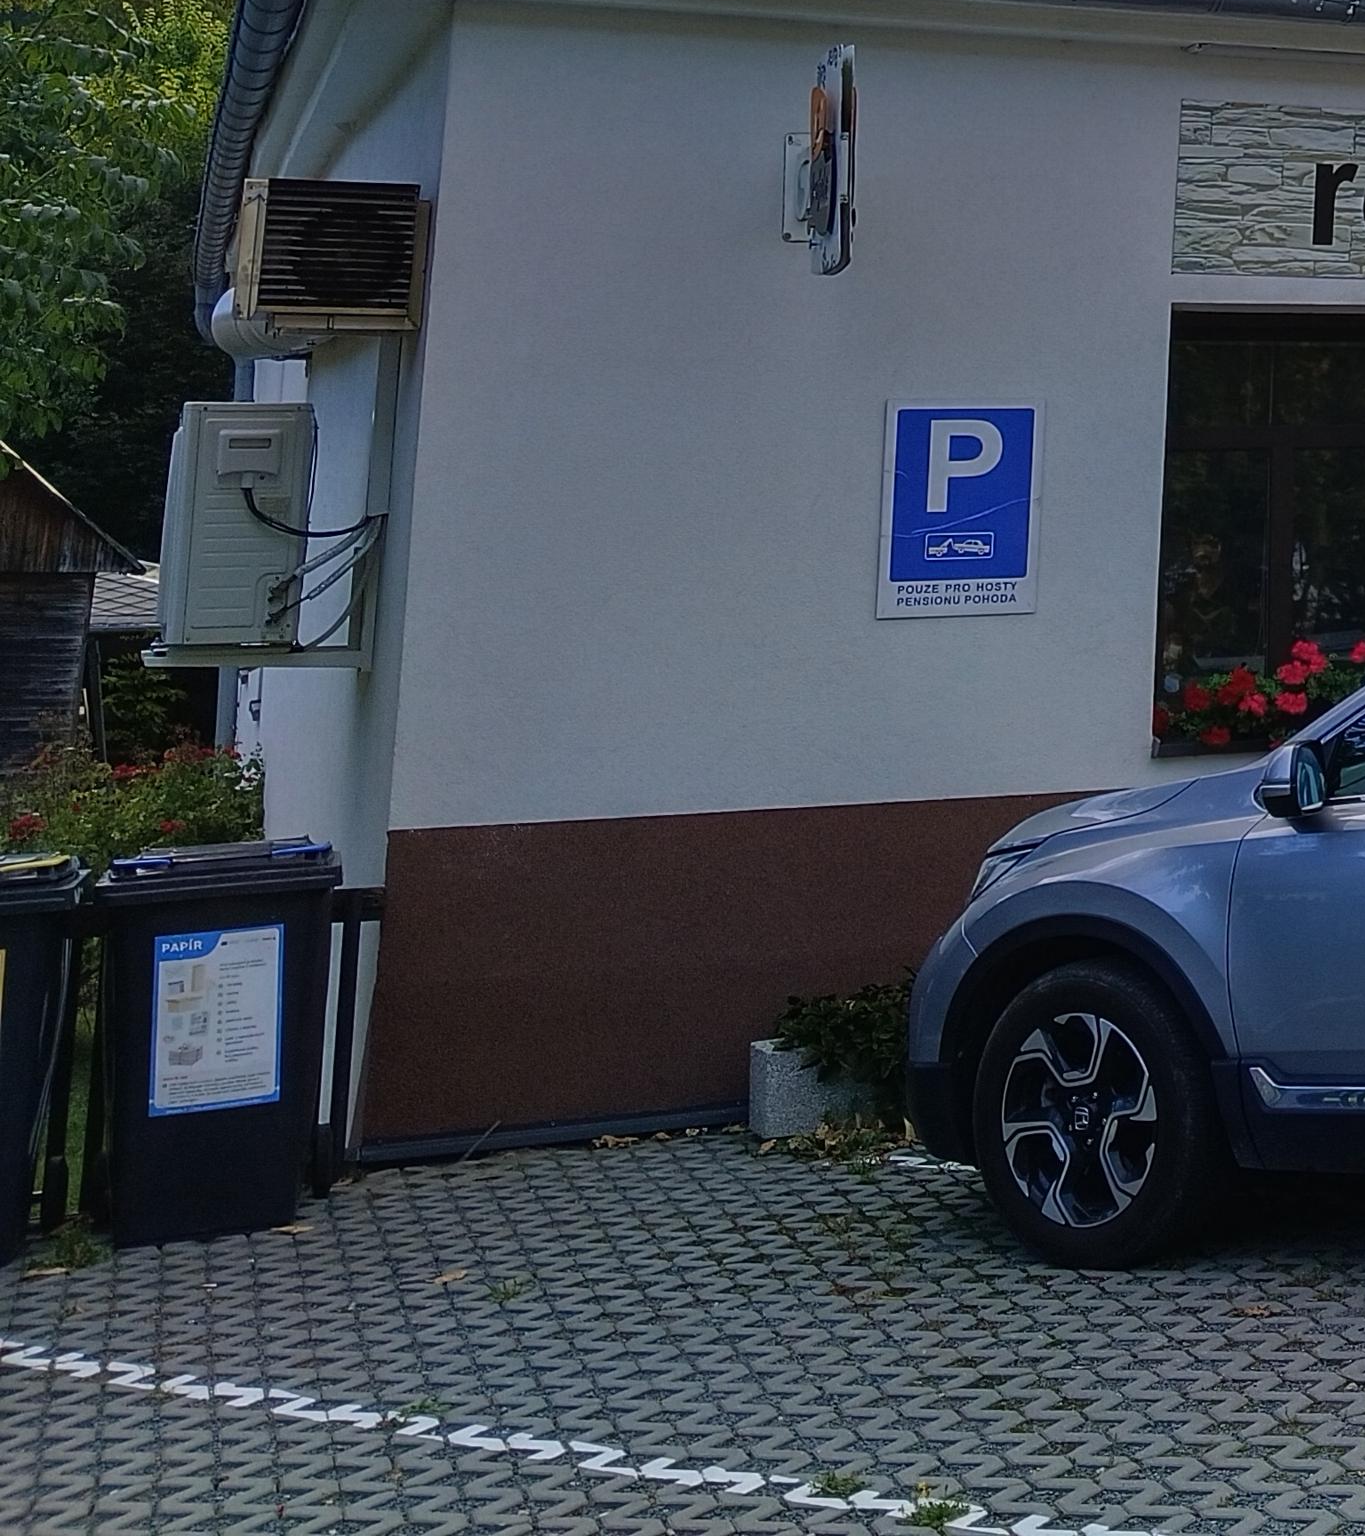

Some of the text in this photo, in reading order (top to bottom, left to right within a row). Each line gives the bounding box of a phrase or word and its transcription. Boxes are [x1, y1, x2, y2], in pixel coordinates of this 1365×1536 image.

[927, 419, 1003, 512] P
[898, 581, 1017, 595] POUZE PRO HOSTY
[897, 594, 1017, 607] PENSIONU POHODA
[162, 938, 202, 954] PAPÍR
